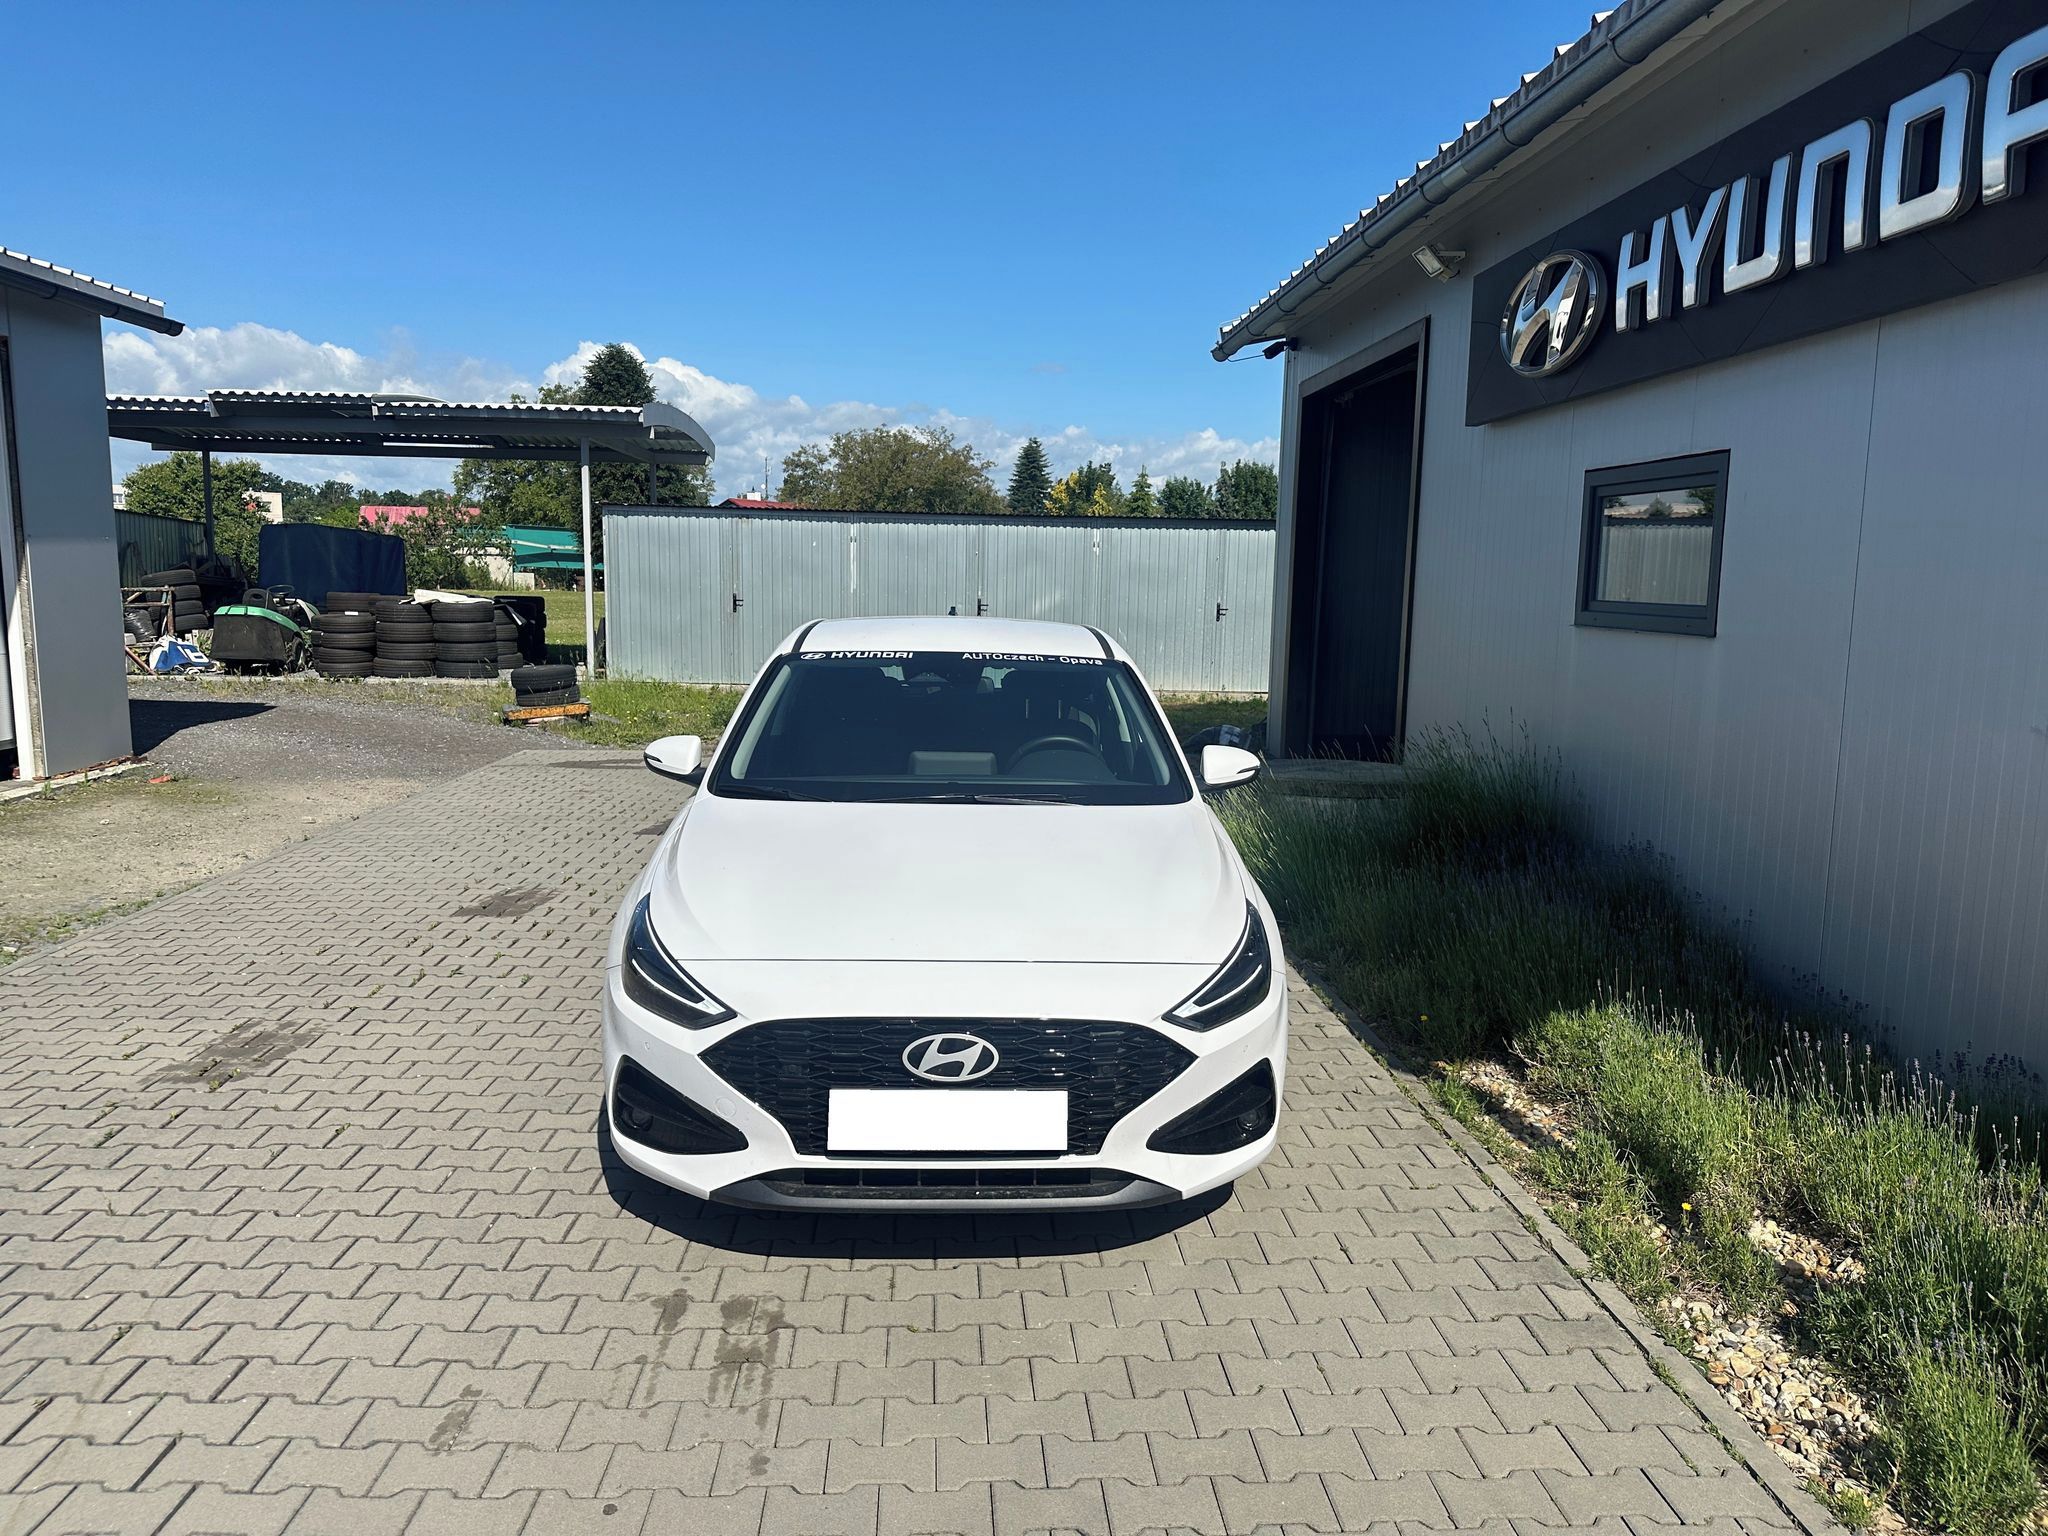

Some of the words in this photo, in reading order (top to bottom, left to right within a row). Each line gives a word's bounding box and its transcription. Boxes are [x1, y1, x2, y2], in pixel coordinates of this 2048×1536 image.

[830, 651, 914, 659] HYUNDAI
[962, 652, 1044, 662] AUTOczech
[1059, 656, 1104, 665] Opava
